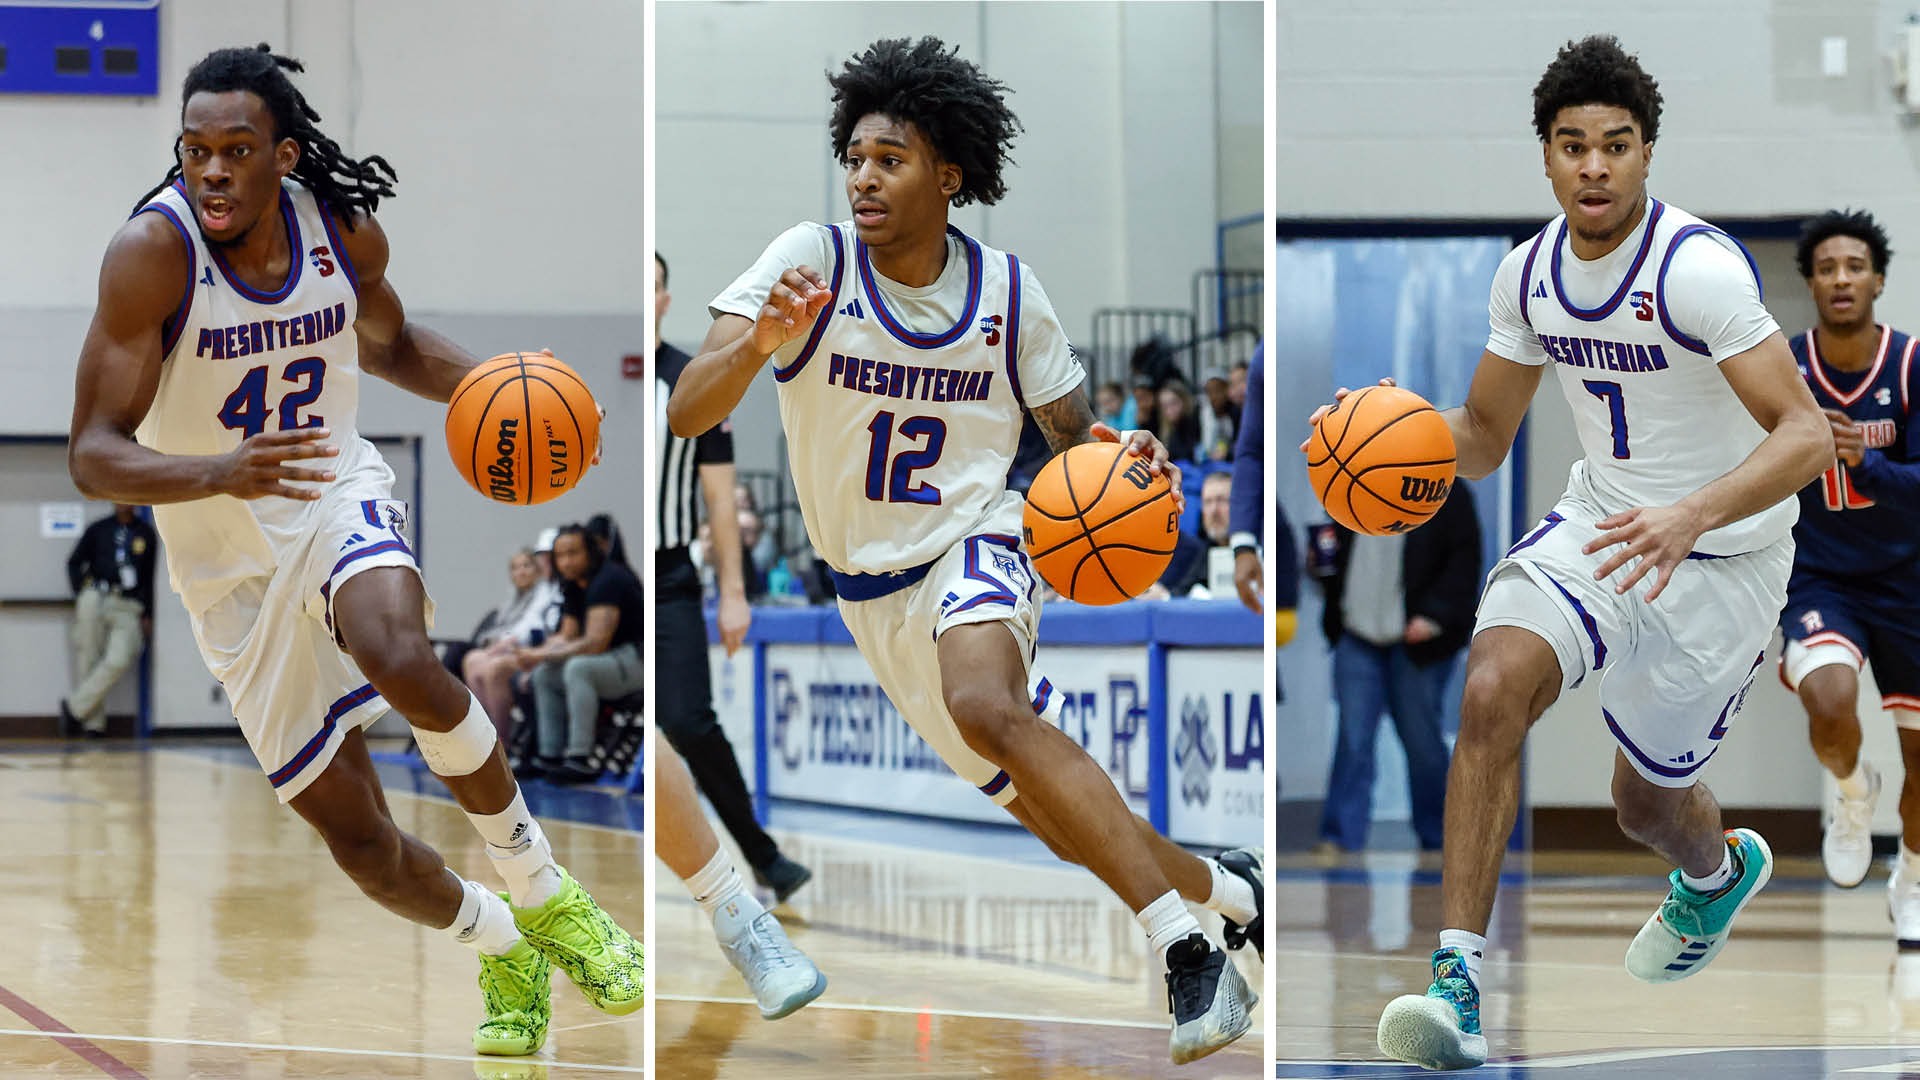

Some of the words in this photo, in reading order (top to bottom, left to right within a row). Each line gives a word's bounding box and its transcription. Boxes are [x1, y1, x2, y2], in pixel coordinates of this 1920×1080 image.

[217, 356, 327, 441] 42
[828, 352, 994, 403] PRESBYTERIAN
[1582, 379, 1631, 460] 7
[487, 418, 519, 503] Wilson
[865, 410, 947, 506] 12
